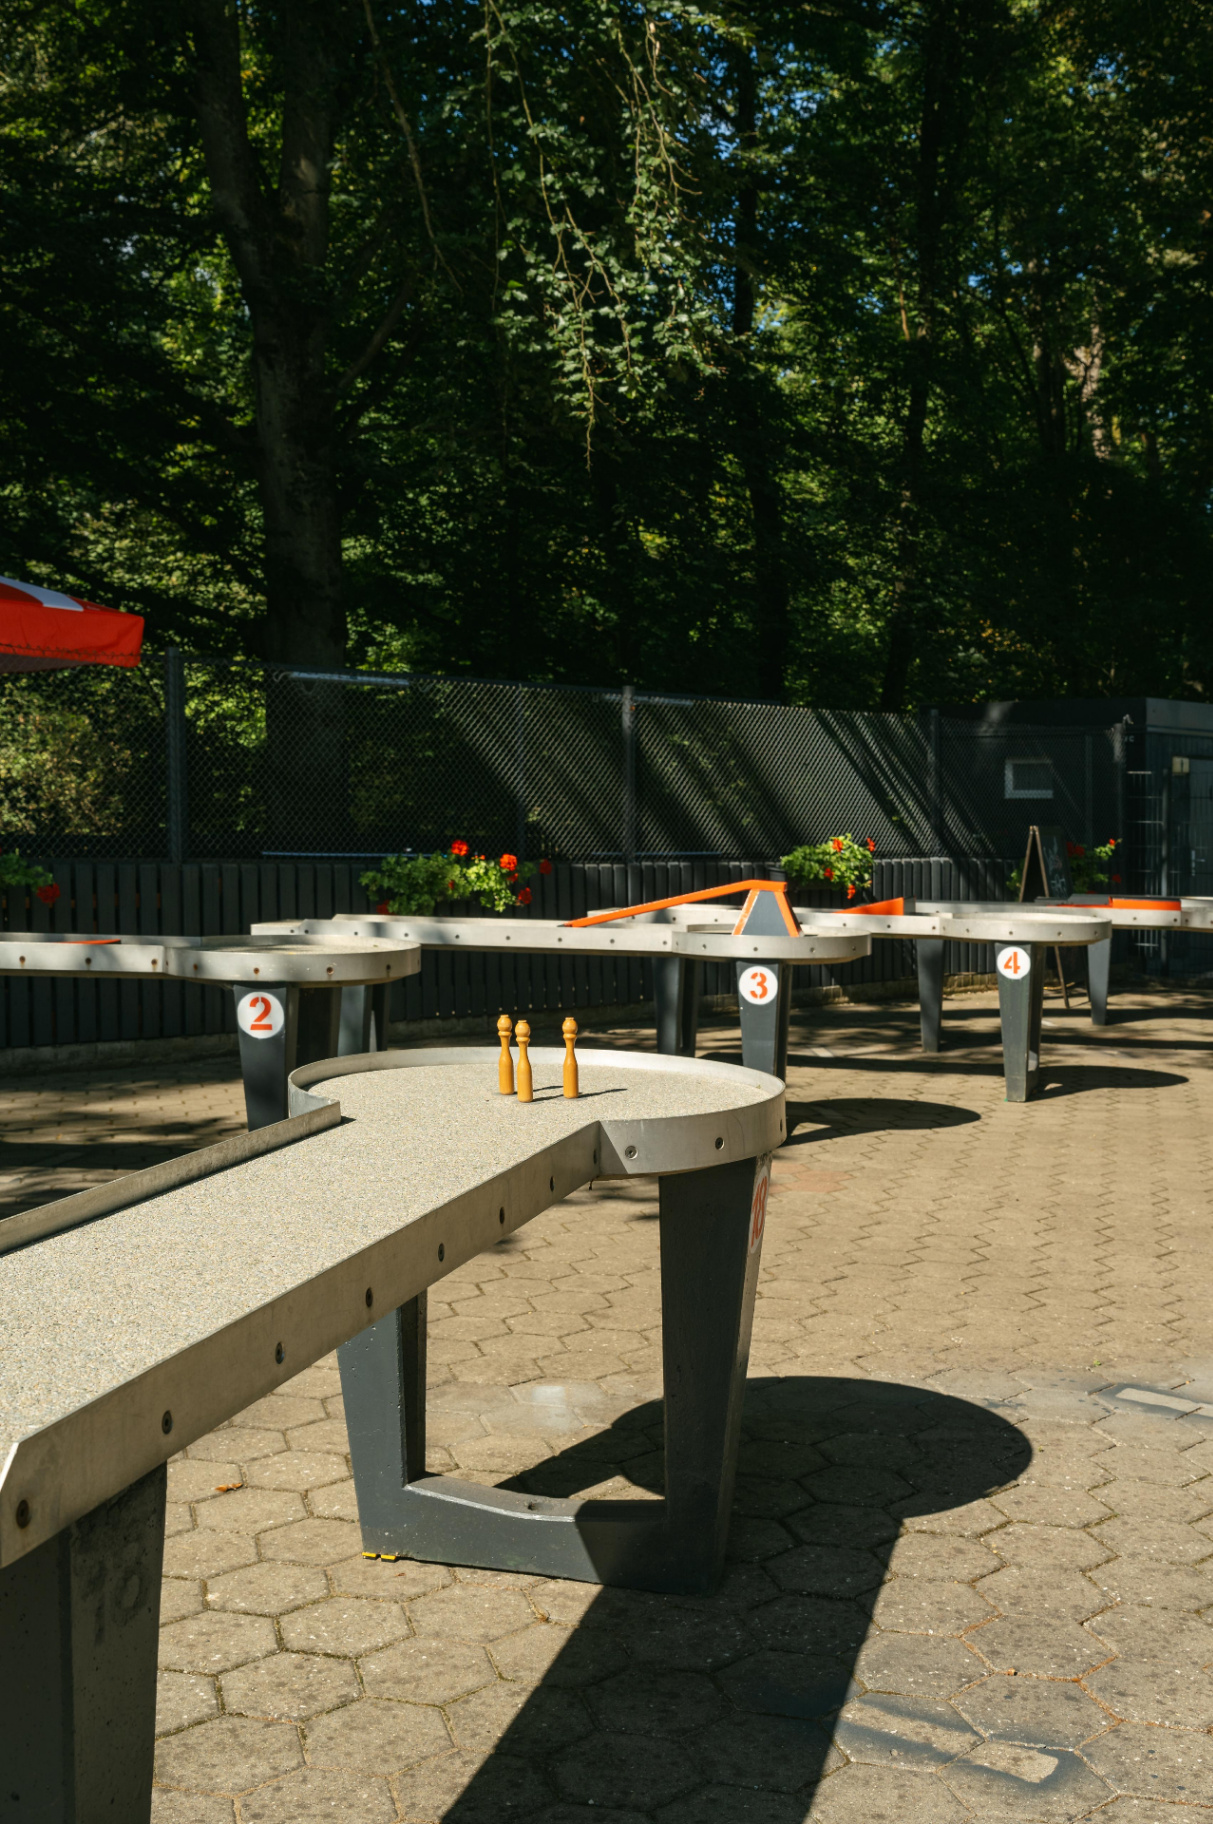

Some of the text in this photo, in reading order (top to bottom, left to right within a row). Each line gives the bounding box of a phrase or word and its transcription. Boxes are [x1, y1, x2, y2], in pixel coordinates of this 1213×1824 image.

[1004, 951, 1020, 974] 4
[750, 972, 768, 999] 3
[249, 996, 273, 1031] 2
[750, 1175, 768, 1248] 18
